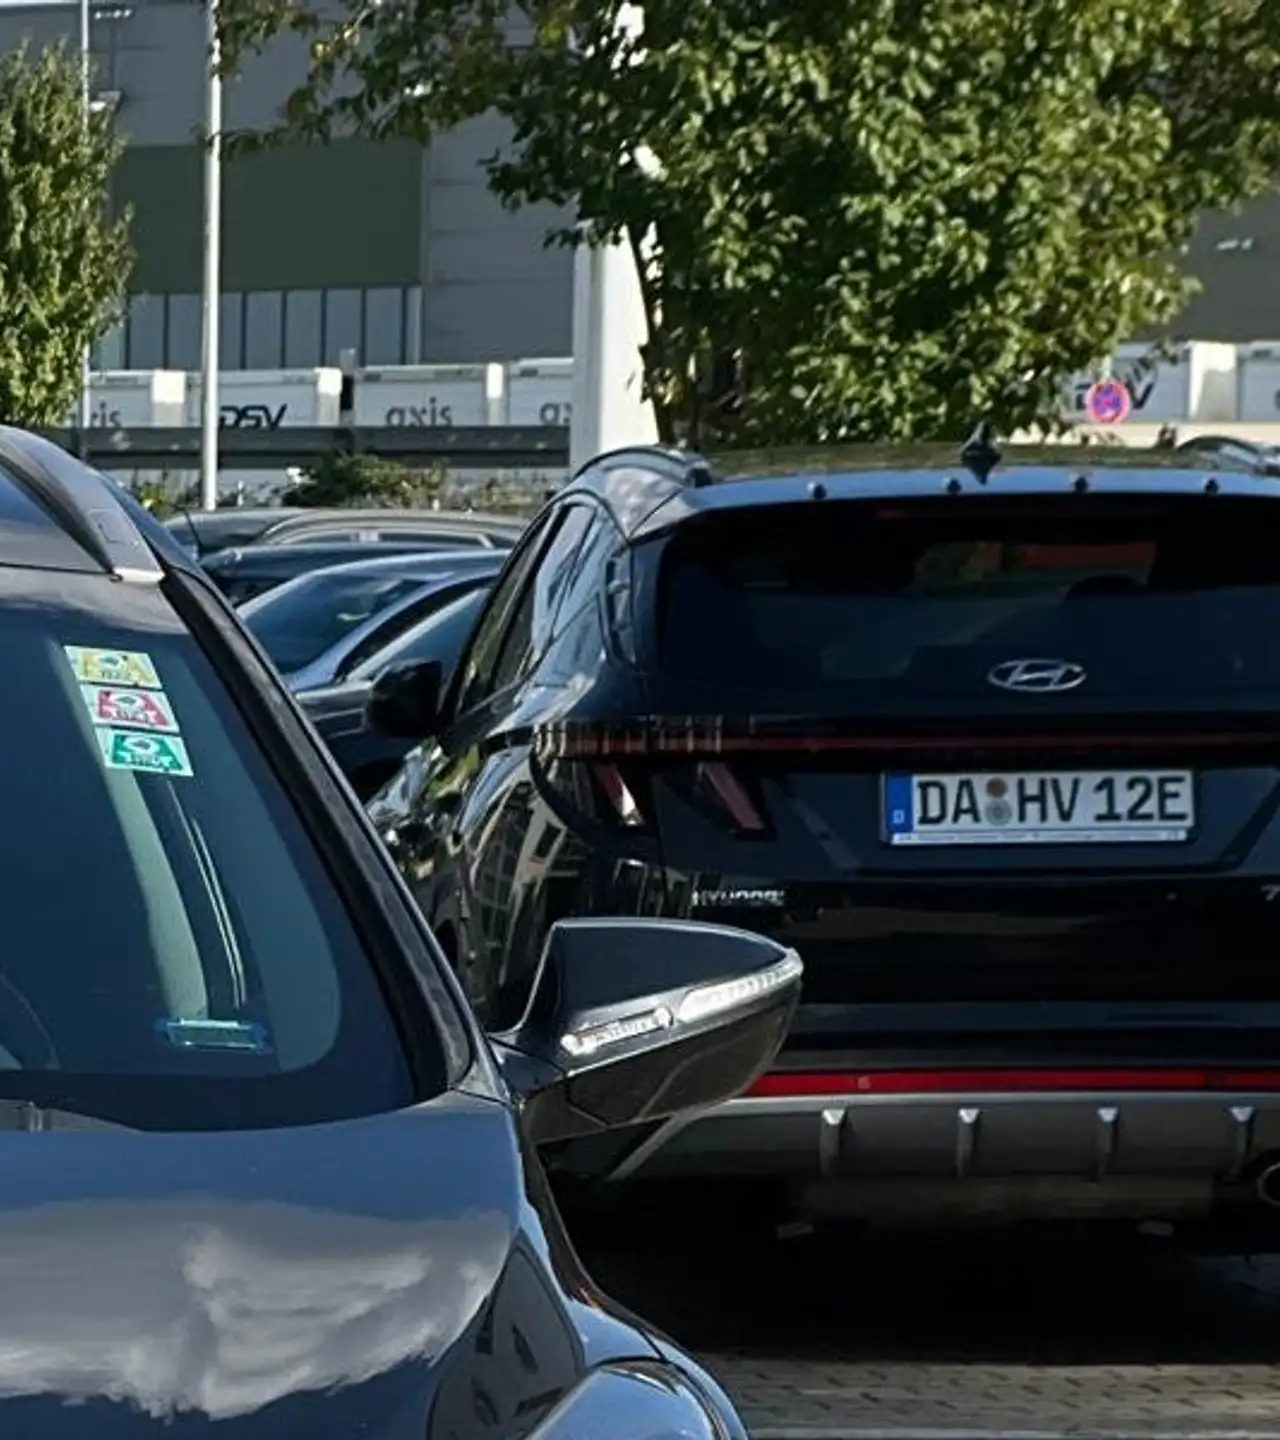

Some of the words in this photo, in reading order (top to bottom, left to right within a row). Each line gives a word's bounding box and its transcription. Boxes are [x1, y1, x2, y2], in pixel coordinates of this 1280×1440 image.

[219, 403, 288, 429] DSV
[384, 396, 453, 427] axis
[917, 777, 981, 825] DA
[1017, 777, 1082, 823] HV
[1093, 776, 1190, 822] 12E
